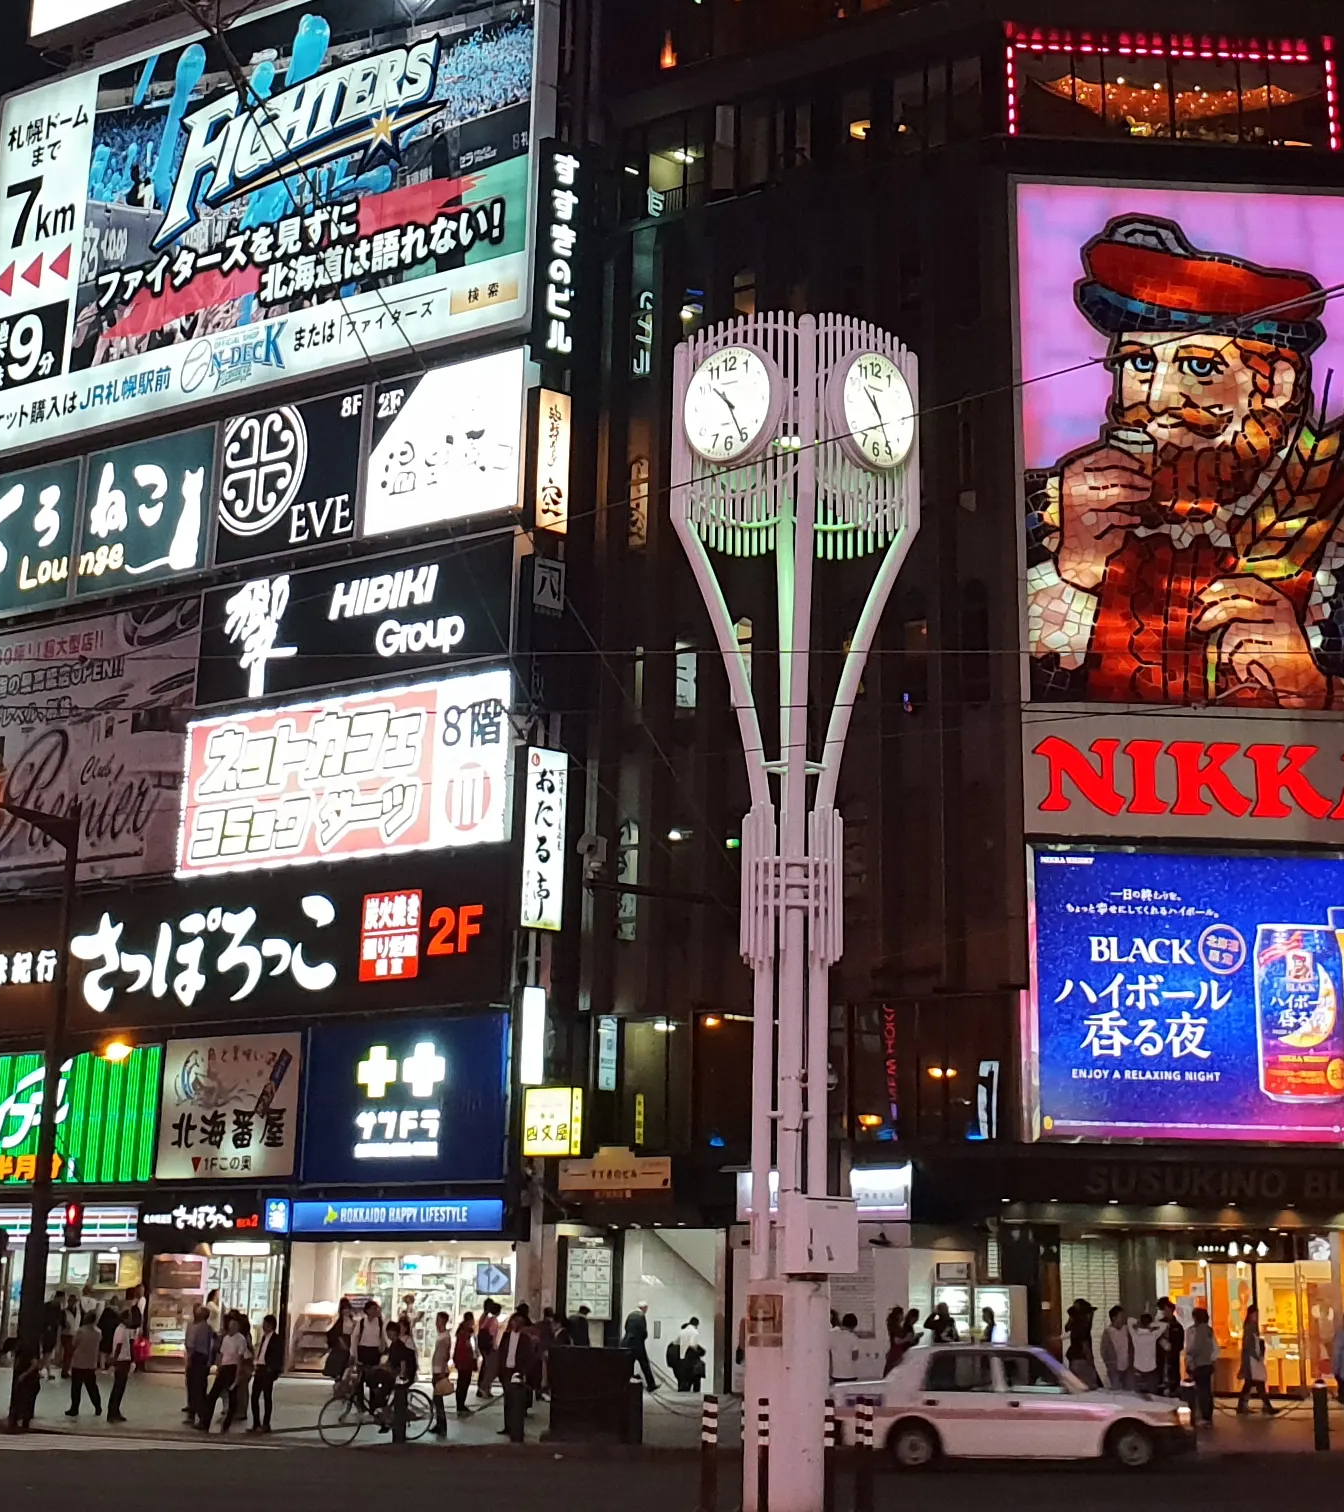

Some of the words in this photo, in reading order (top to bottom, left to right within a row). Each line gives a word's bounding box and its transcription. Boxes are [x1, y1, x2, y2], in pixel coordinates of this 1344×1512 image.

[8, 104, 90, 152] 札幌ドーム
[153, 34, 442, 248] FIGHTERS
[30, 139, 62, 167] まで
[6, 174, 76, 249] 7km
[97, 202, 358, 309] ファイターズを見ずに
[546, 152, 582, 355] すすきのビル
[467, 281, 500, 304] 検索
[293, 318, 336, 350] または
[346, 298, 435, 337] ファイターズ
[9, 313, 55, 381] 9分
[722, 355, 738, 373] 12
[707, 364, 721, 381] 11
[742, 359, 750, 374] 1
[857, 363, 869, 379] 11
[886, 374, 892, 388] 1
[869, 362, 882, 379] 12
[340, 392, 362, 418] 8F
[377, 388, 405, 419] 2F
[711, 433, 721, 450] 7
[723, 435, 734, 451] 6
[871, 441, 881, 458] 6
[287, 492, 354, 544] EVE
[19, 542, 125, 589] Lounge
[327, 563, 440, 621] HIBIKI
[374, 614, 466, 658] Group
[442, 697, 502, 748] 8階
[196, 707, 424, 796] ネットカフェ
[190, 796, 312, 861] コミック
[426, 904, 484, 956] 2F
[1088, 936, 1196, 965] BLACK
[69, 894, 336, 1013] さっぽろっこ
[1054, 972, 1233, 1011] ハイボール
[1080, 1010, 1212, 1059] 香る夜
[1071, 1068, 1109, 1080] ENJOY
[1112, 1069, 1122, 1080] A
[1124, 1069, 1182, 1082] RELAXING
[1184, 1070, 1222, 1082] NIGHT
[171, 1107, 287, 1150] 北海番屋
[1084, 1165, 1289, 1199] SUSUKINO
[340, 1206, 386, 1225] HOKKAIDO
[388, 1207, 418, 1226] HAPPY
[419, 1205, 469, 1225] LIFESTYLE
